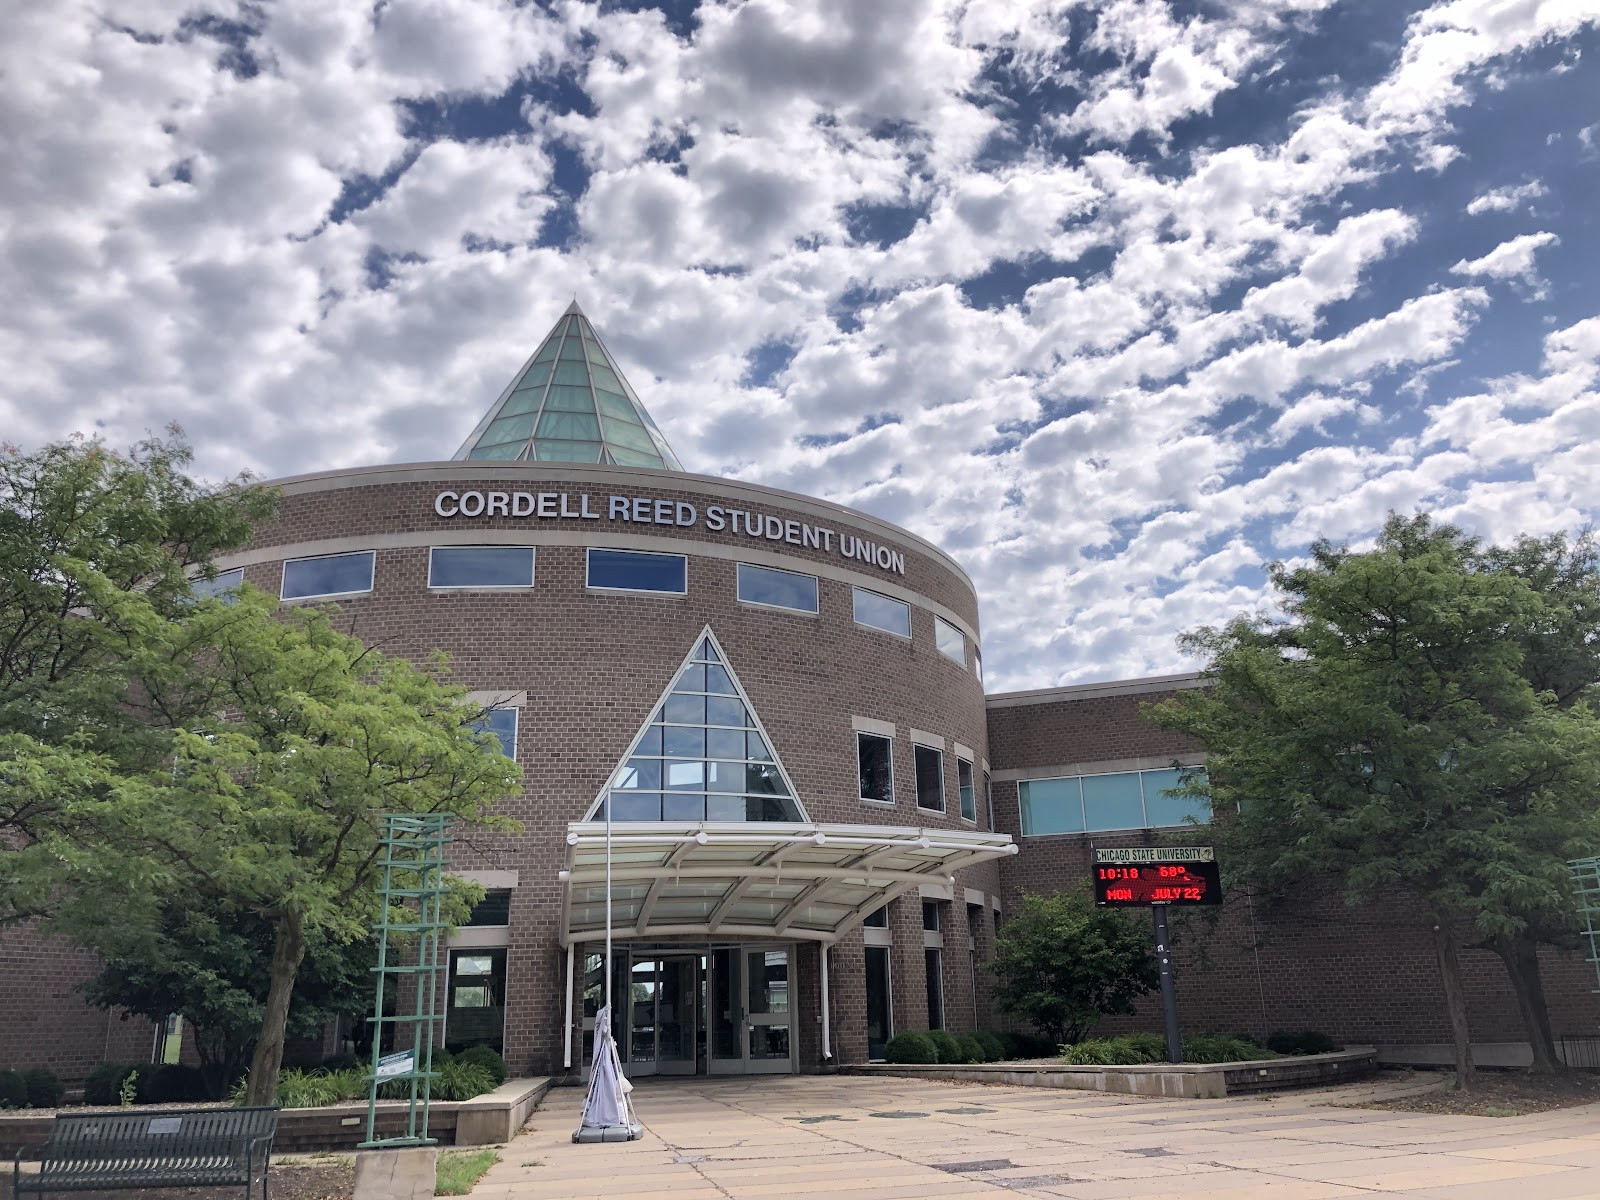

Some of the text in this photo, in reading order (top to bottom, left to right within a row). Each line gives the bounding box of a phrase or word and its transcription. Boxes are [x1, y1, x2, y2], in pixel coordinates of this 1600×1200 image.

[434, 490, 905, 575] CORDELL REED STUDENT UNION
[1096, 848, 1201, 861] CHICAGO STATE UNIVERSITY
[1099, 868, 1139, 879] 10:18
[1106, 888, 1132, 900] MON
[1152, 887, 1181, 899] JULY
